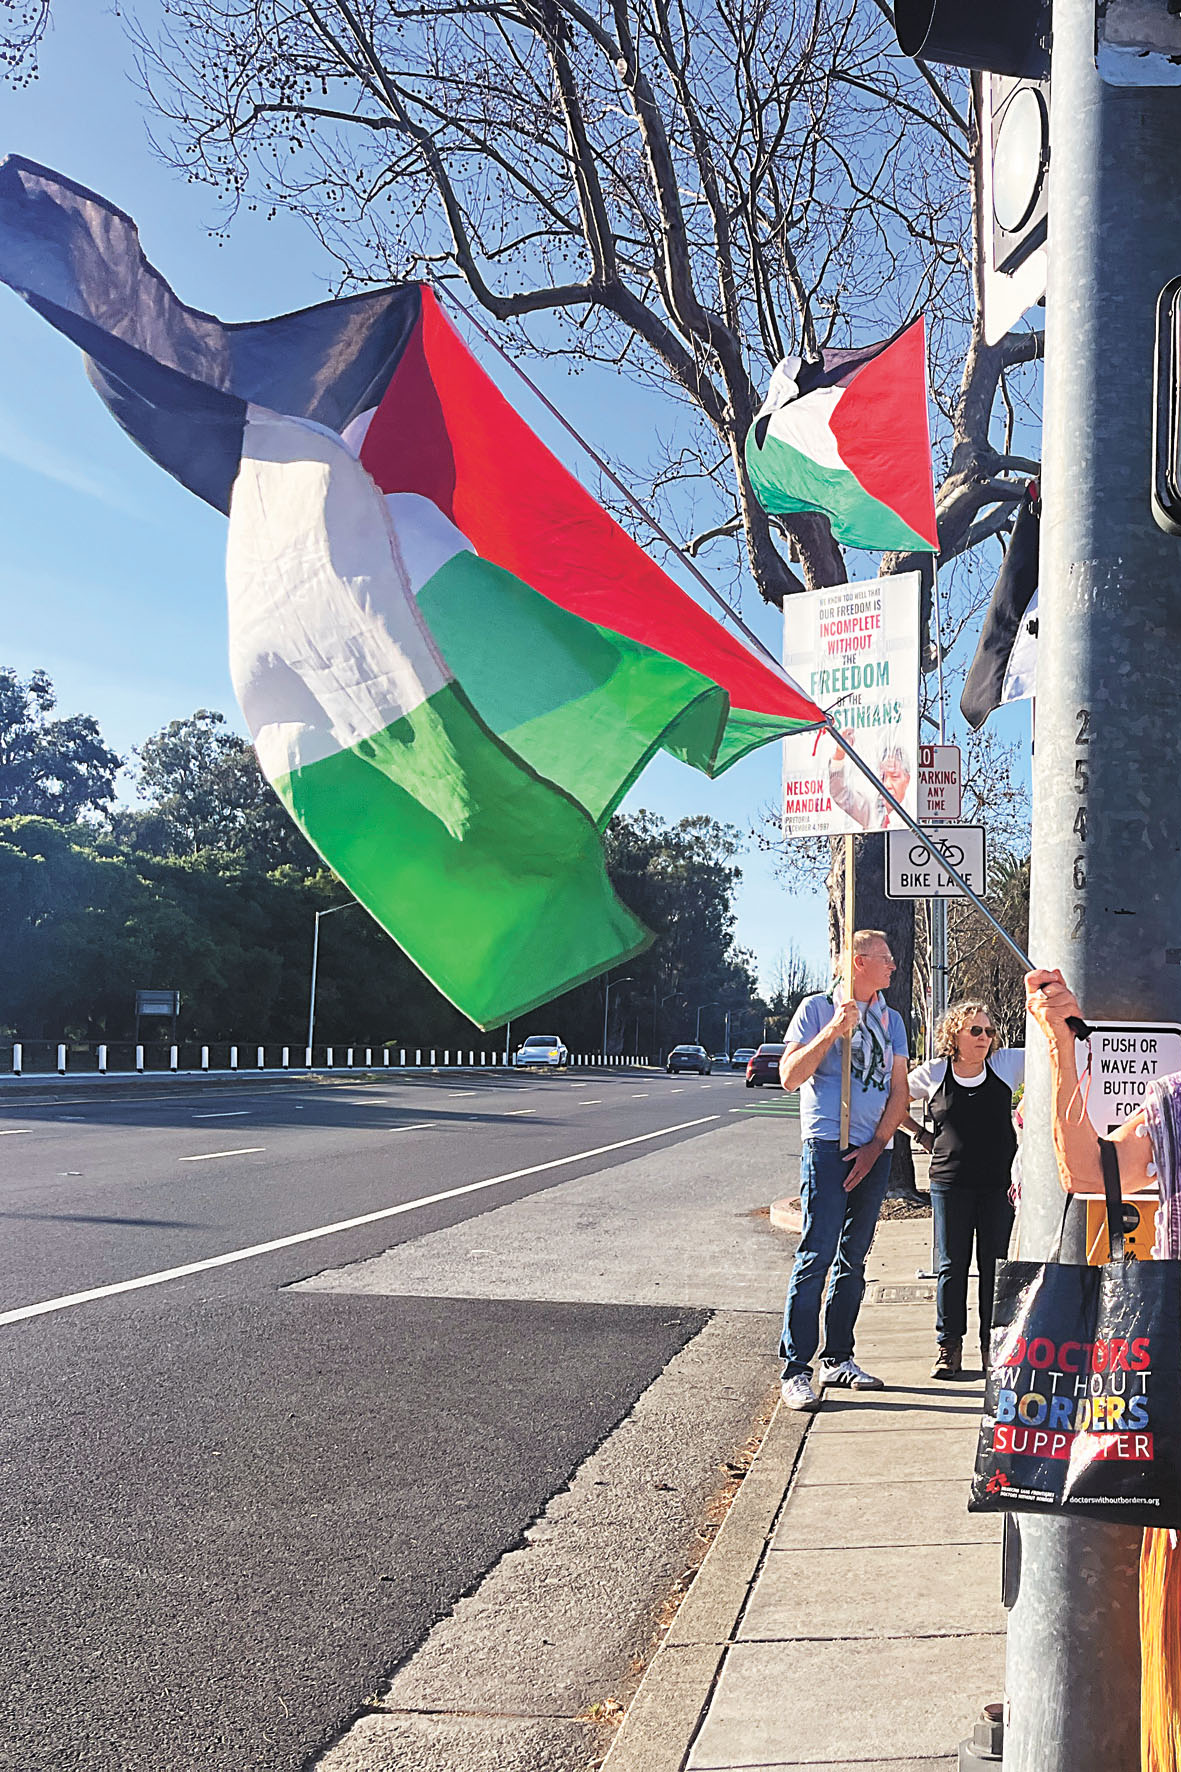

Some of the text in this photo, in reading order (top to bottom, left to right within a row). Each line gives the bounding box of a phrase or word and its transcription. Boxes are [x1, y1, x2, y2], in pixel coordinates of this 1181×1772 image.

[844, 593, 854, 602] TOO
[854, 591, 867, 600] WELL
[868, 588, 880, 597] THAT
[820, 600, 882, 620] OUR FREEDOM IS
[820, 614, 880, 638] INCOMPLETE
[828, 634, 872, 656] WITHOUT
[842, 653, 856, 666] THE
[810, 660, 890, 696] FREEDOM
[837, 694, 862, 707] OF THE
[830, 700, 902, 731] STINIANS
[786, 780, 824, 796] NELSON
[928, 787, 944, 798] ANY
[786, 797, 832, 814] MANDELA
[928, 800, 946, 810] TIME
[901, 873, 930, 888] BIKE
[1102, 1038, 1157, 1053] PUSH OR
[1101, 1060, 1158, 1074] WAVE AT
[1104, 1081, 1148, 1096] BUTTO
[1004, 1336, 1150, 1372] DOCTORS
[1000, 1366, 1152, 1397] WITHOUT
[997, 1389, 1149, 1431] BORDERS
[995, 1427, 1150, 1458] SUPPER
[1070, 1496, 1160, 1506] doctorswithoutborders.org
